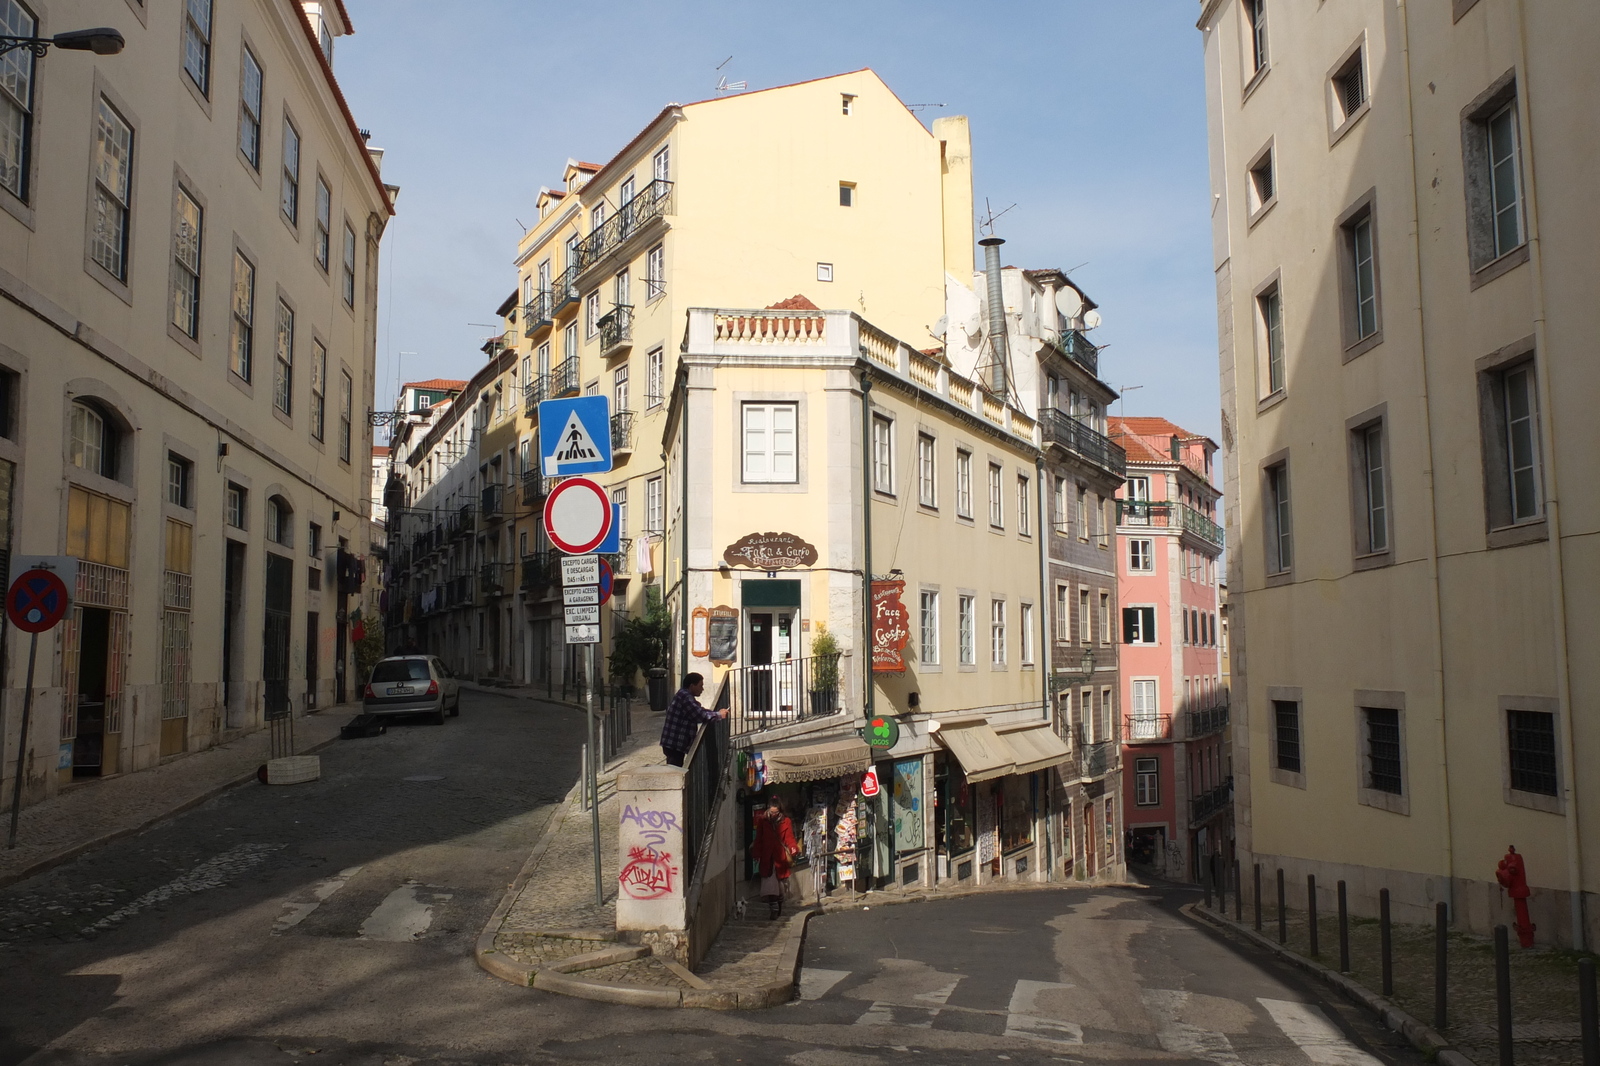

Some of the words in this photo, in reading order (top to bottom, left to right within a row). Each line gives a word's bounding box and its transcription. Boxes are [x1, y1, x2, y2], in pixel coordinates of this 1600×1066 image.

[775, 548, 783, 556] &
[786, 546, 810, 559] Garfo
[562, 559, 581, 567] EXCEPTO
[570, 566, 595, 574] DESCARGAS
[875, 600, 901, 620] Faca
[875, 624, 906, 645] Garfo
[871, 738, 890, 747] JOGOS
